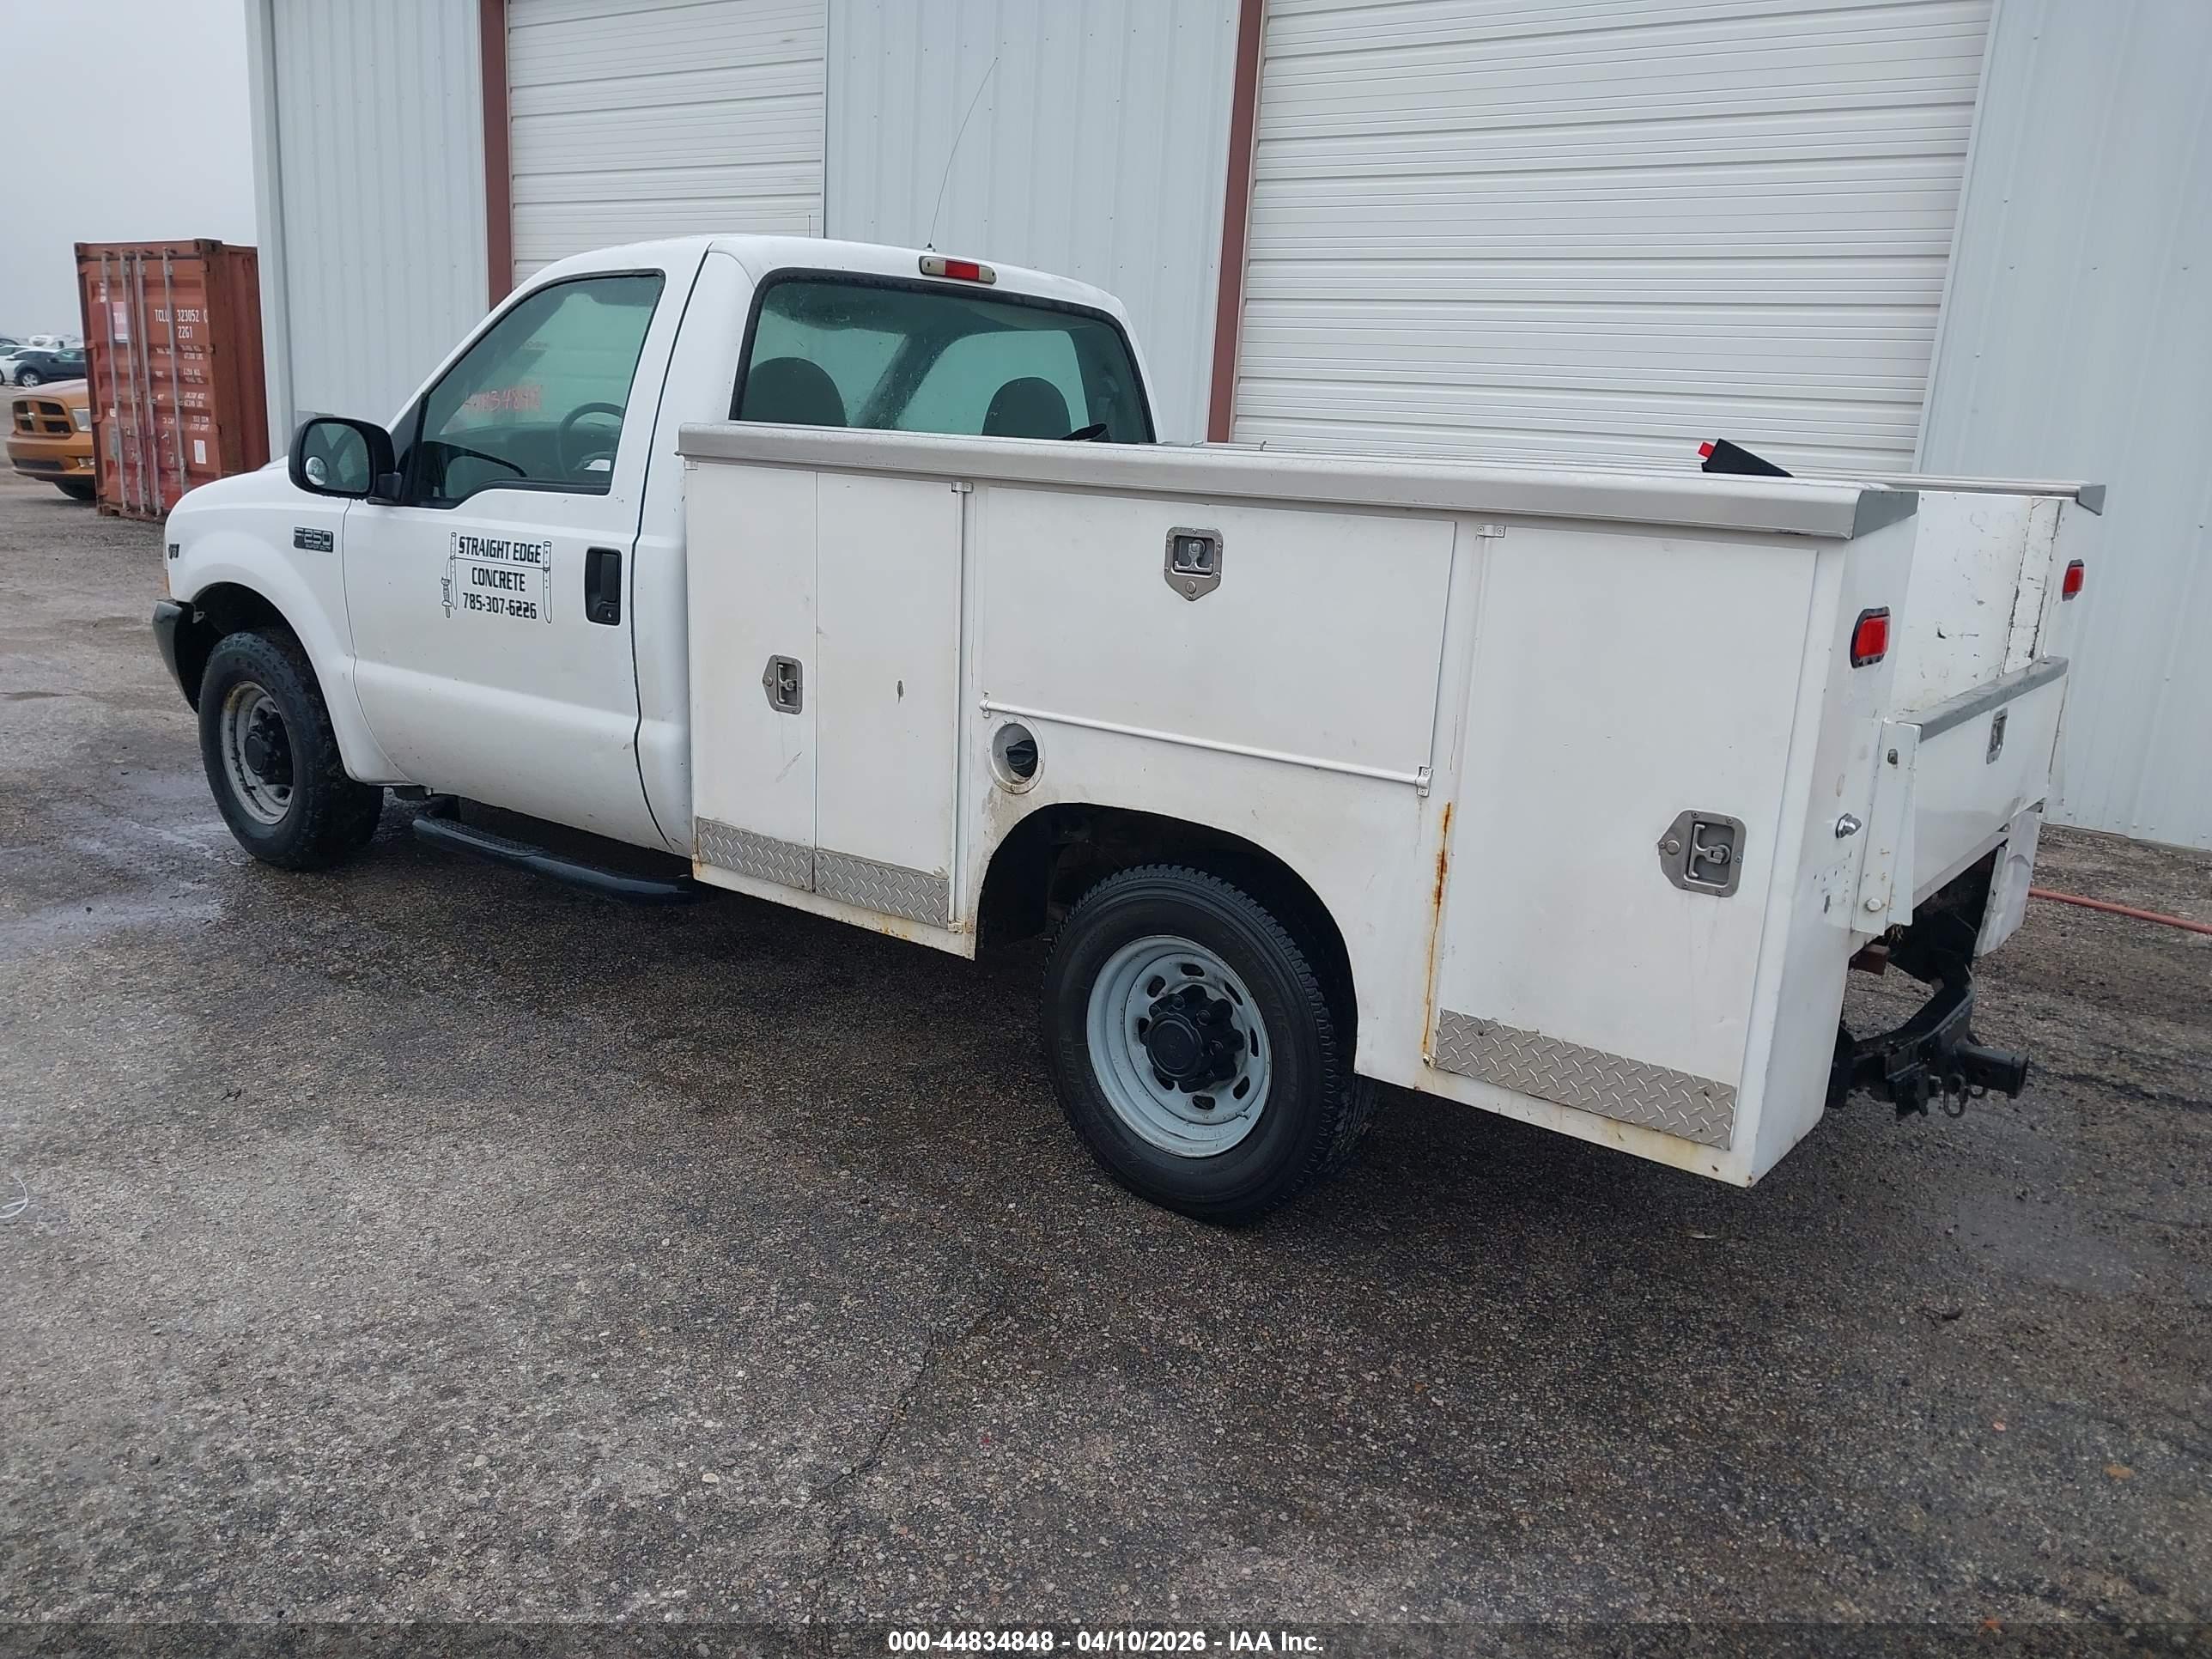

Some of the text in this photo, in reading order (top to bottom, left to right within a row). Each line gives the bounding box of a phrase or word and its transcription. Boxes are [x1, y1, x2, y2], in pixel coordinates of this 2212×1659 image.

[177, 309, 200, 323] 323052
[459, 536, 542, 564] STRAIGHT EDGE
[471, 567, 526, 592] CONCRETE
[462, 592, 538, 620] 785-307-6226
